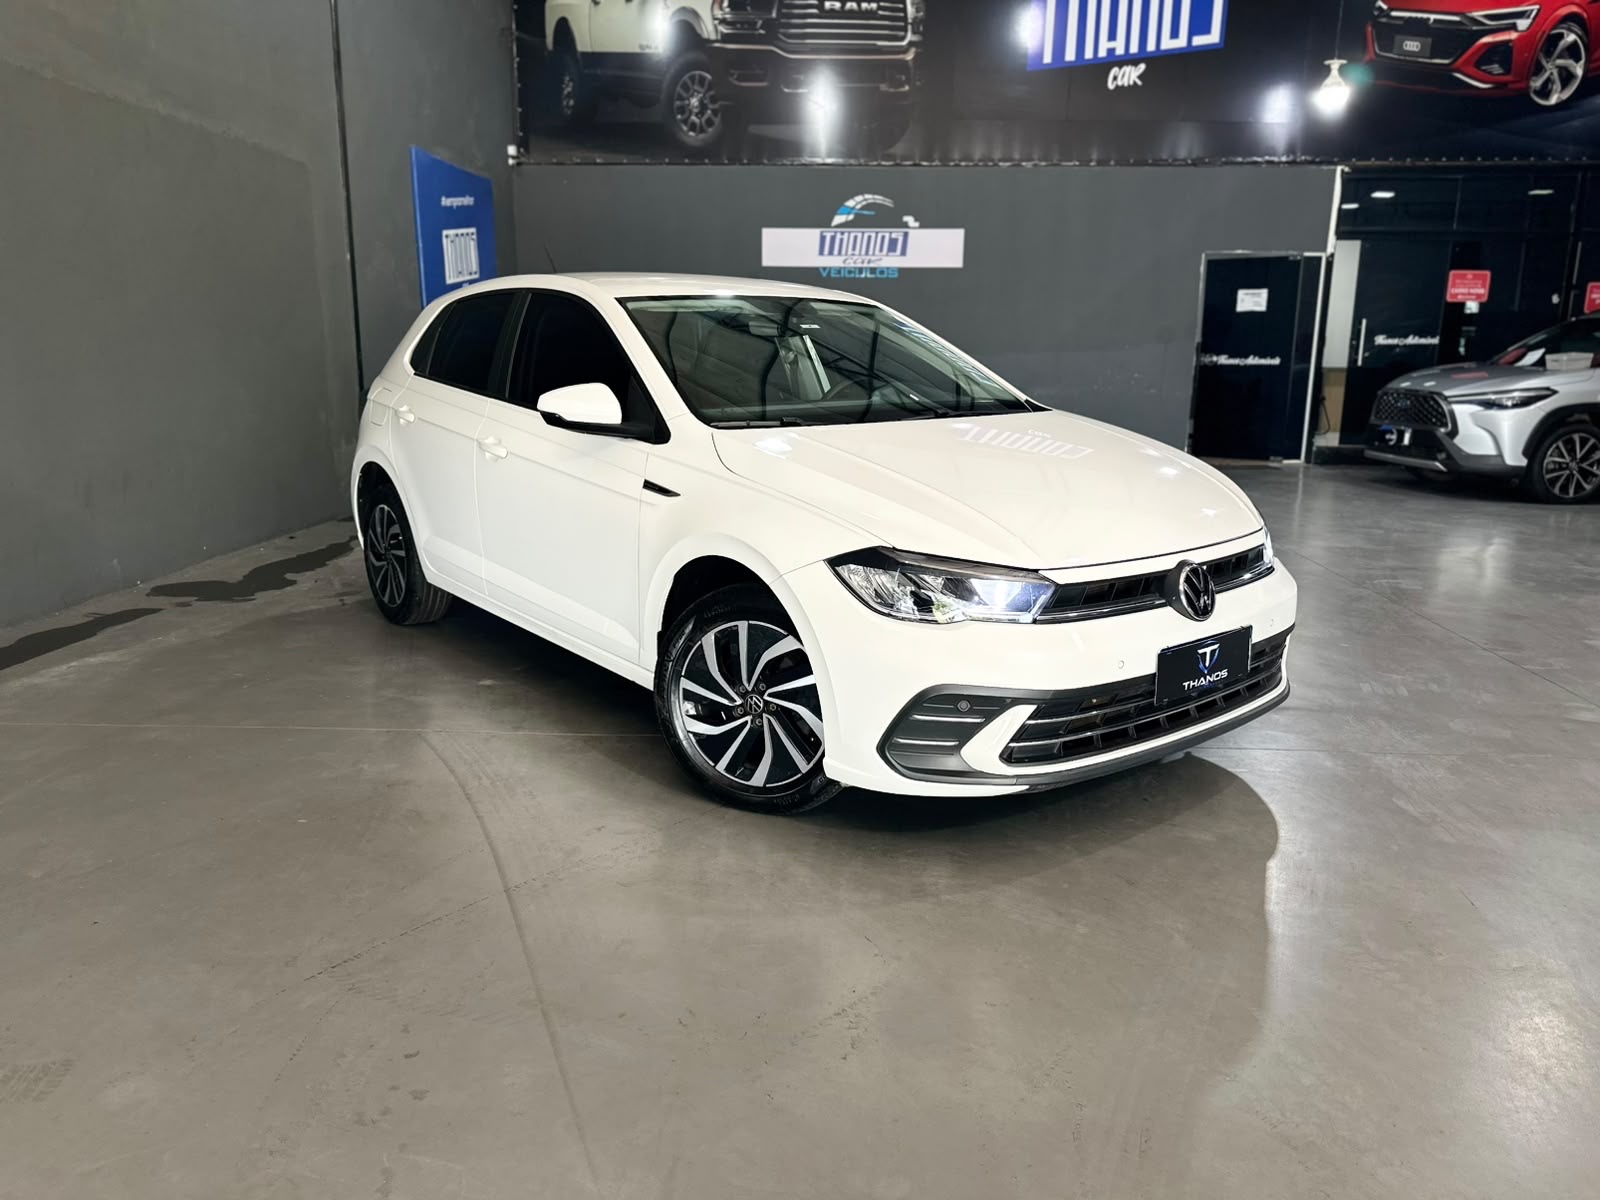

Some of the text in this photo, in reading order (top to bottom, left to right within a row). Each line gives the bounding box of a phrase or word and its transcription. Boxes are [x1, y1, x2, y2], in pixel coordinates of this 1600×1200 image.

[824, 1, 878, 11] RAM
[822, 232, 904, 256] THANOS
[1182, 668, 1229, 691] THANOS
